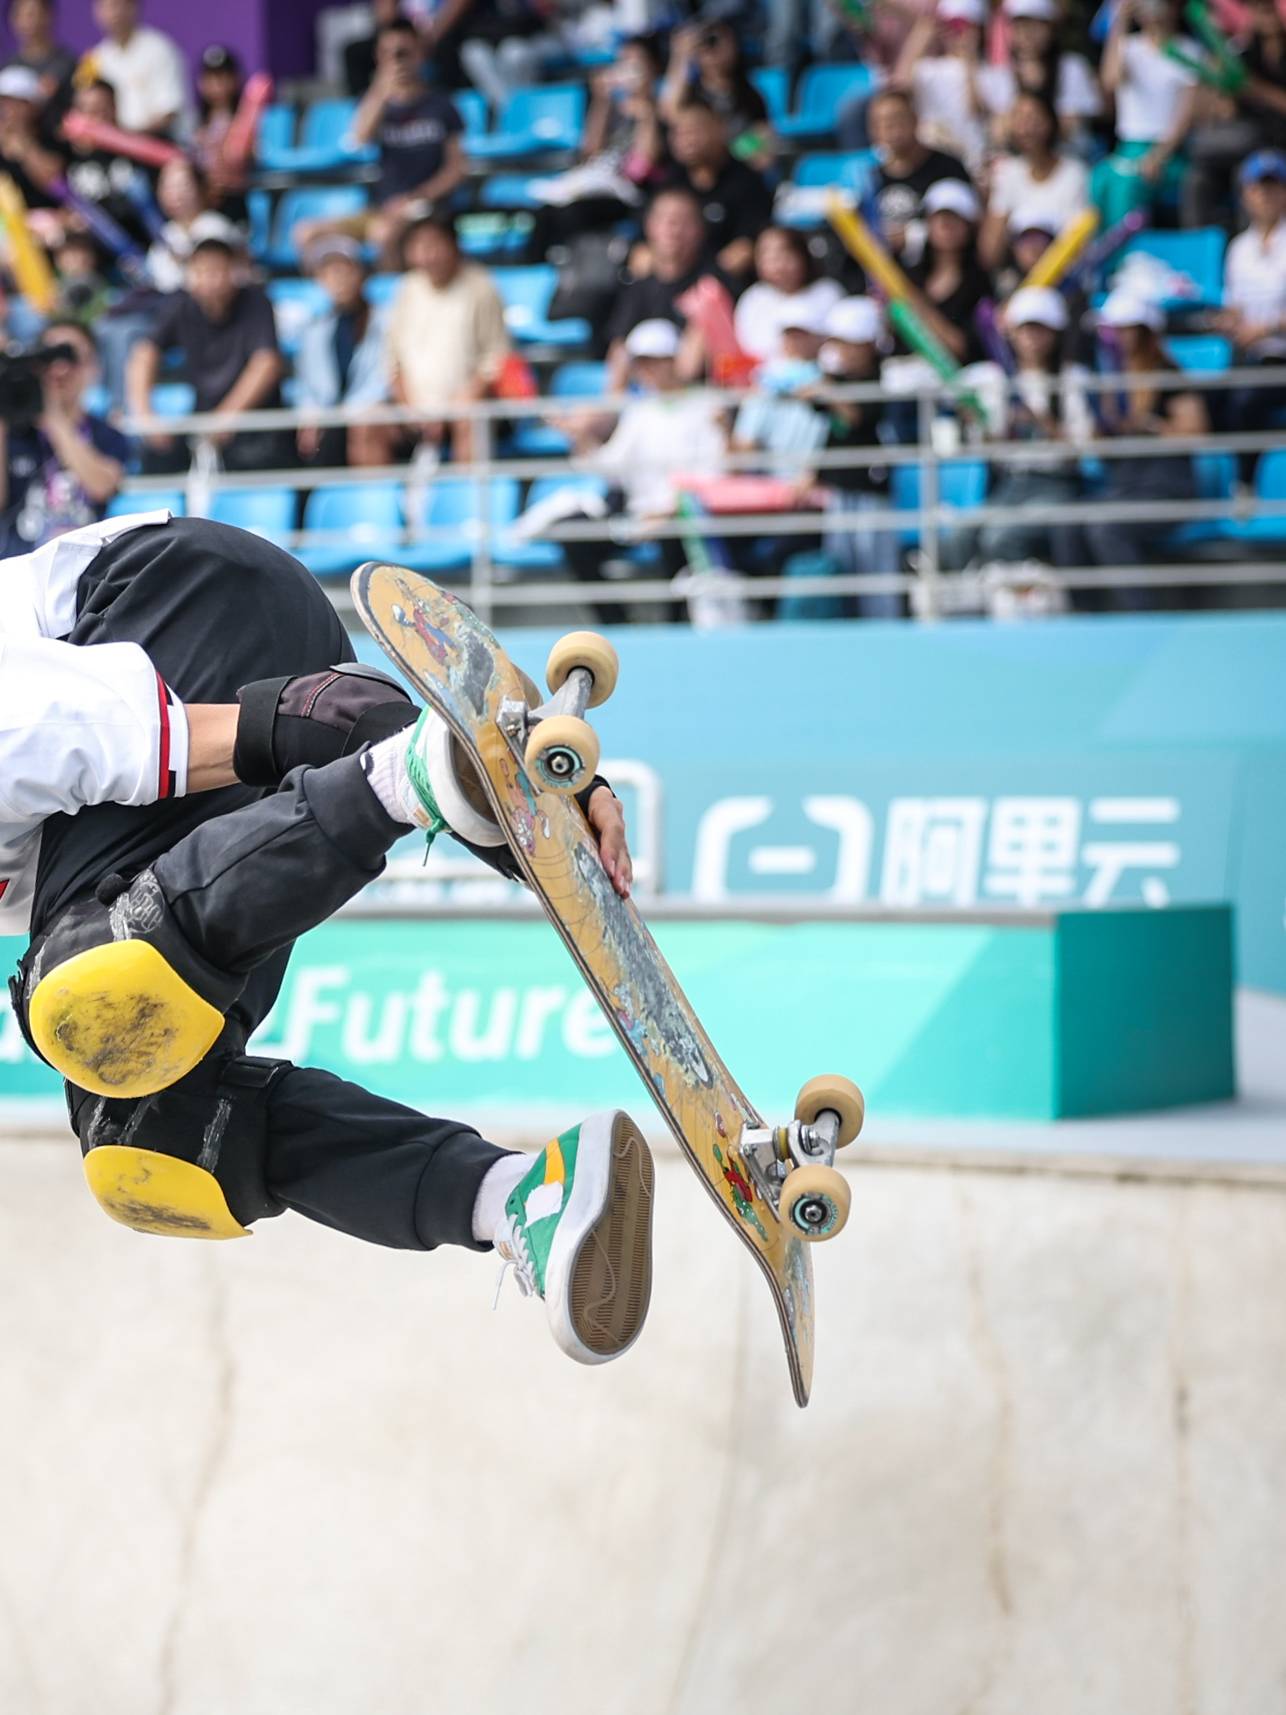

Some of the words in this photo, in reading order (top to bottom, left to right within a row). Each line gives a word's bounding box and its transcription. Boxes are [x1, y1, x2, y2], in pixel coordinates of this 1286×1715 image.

[880, 796, 1181, 909] 阿里云
[245, 964, 622, 1064] Future
